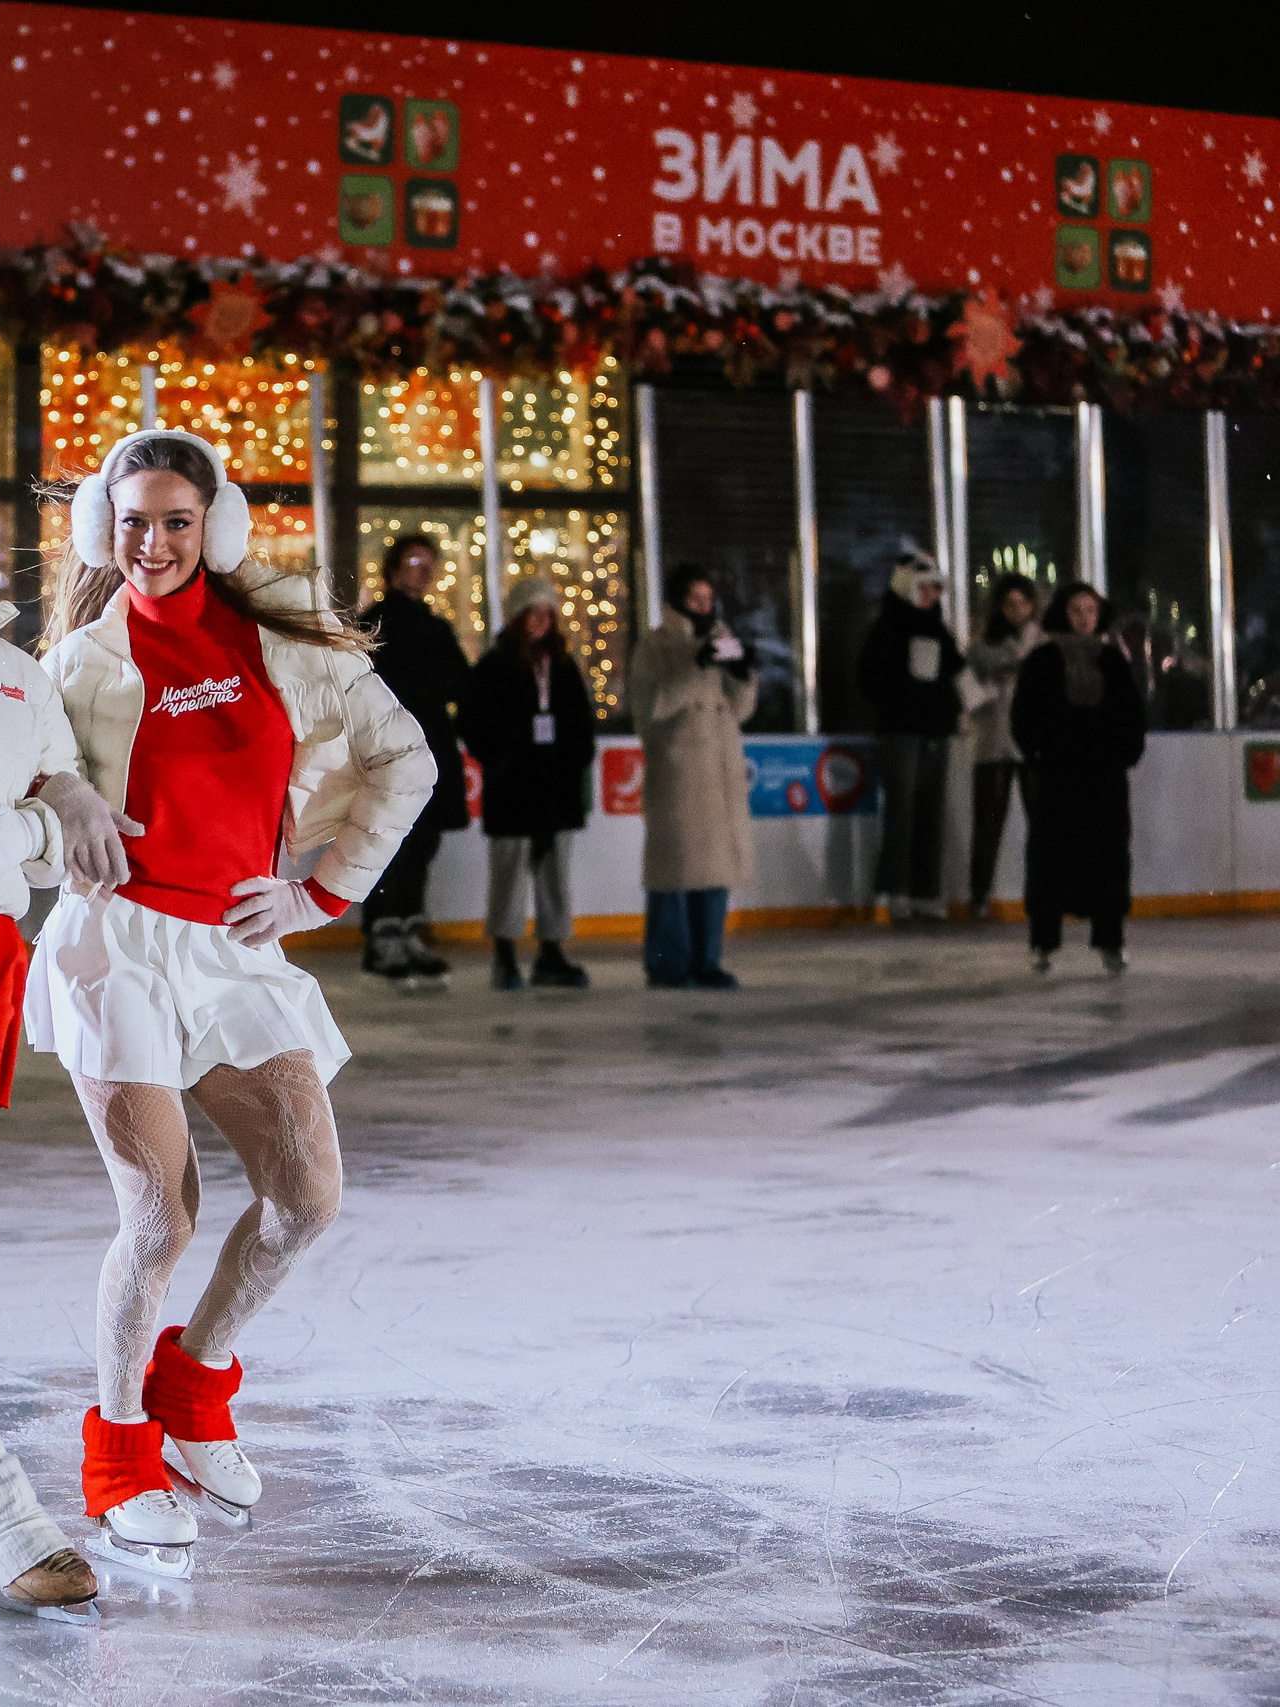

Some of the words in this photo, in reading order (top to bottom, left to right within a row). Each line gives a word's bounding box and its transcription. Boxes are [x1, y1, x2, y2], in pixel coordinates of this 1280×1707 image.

[652, 127, 881, 215] ЗИМА
[652, 212, 683, 252] В
[696, 215, 882, 266] МОСКВЕ
[150, 675, 241, 713] Московское
[161, 689, 243, 718] чаепитие
